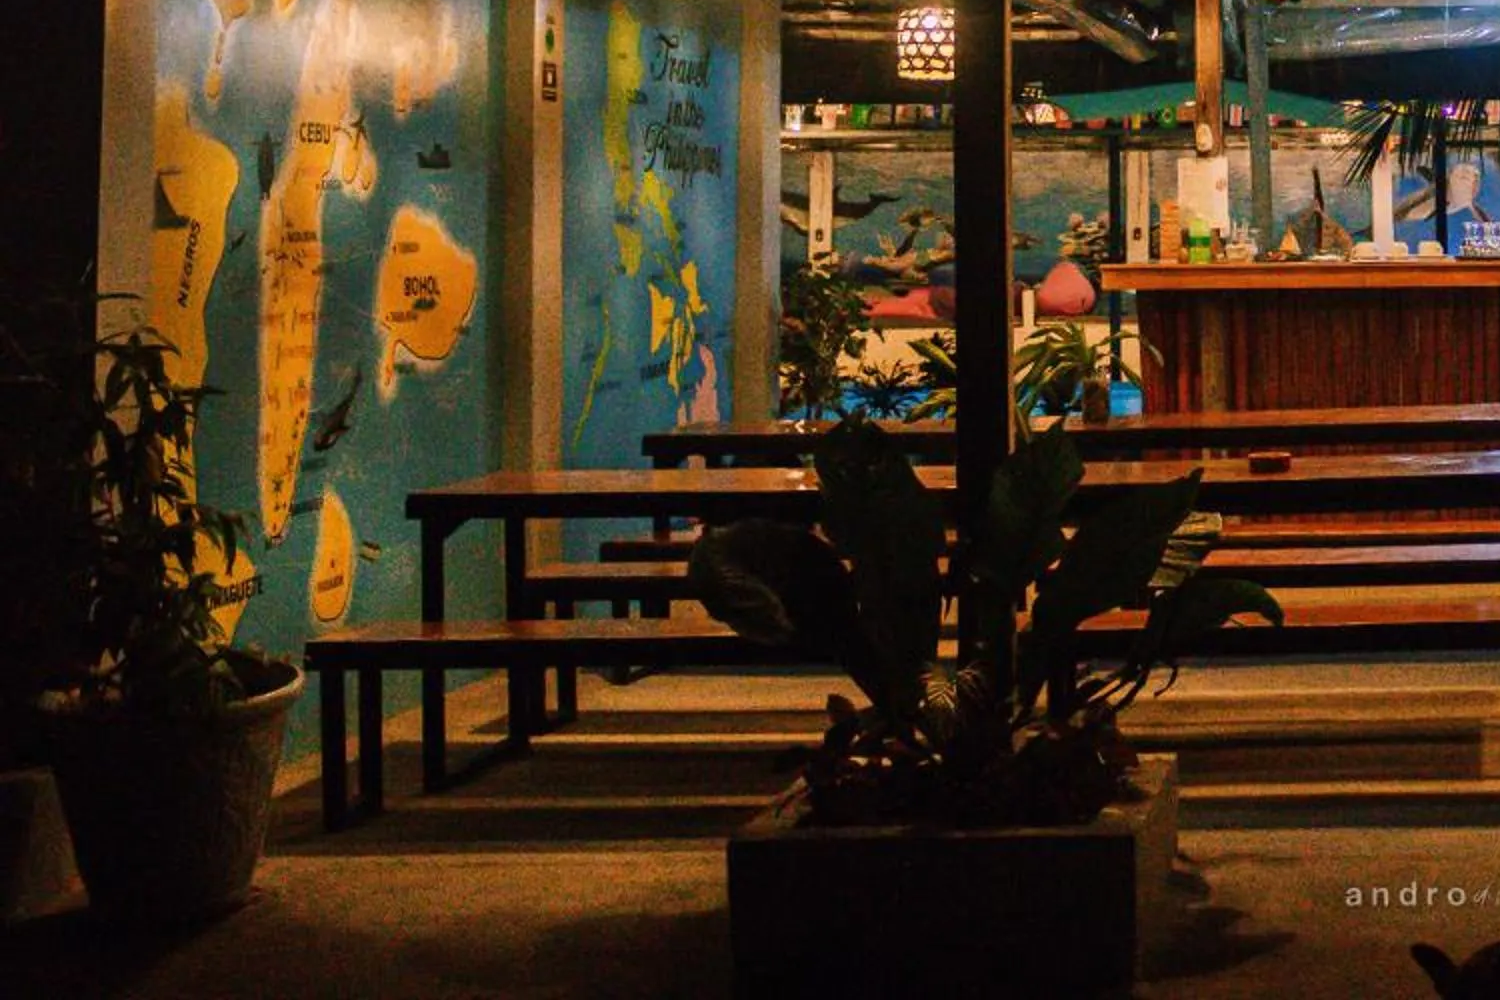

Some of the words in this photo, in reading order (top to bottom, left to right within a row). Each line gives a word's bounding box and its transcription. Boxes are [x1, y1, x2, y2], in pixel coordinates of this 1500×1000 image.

[300, 122, 330, 144] CEBU
[177, 218, 201, 308] NEGROS
[404, 275, 441, 297] BOHOL
